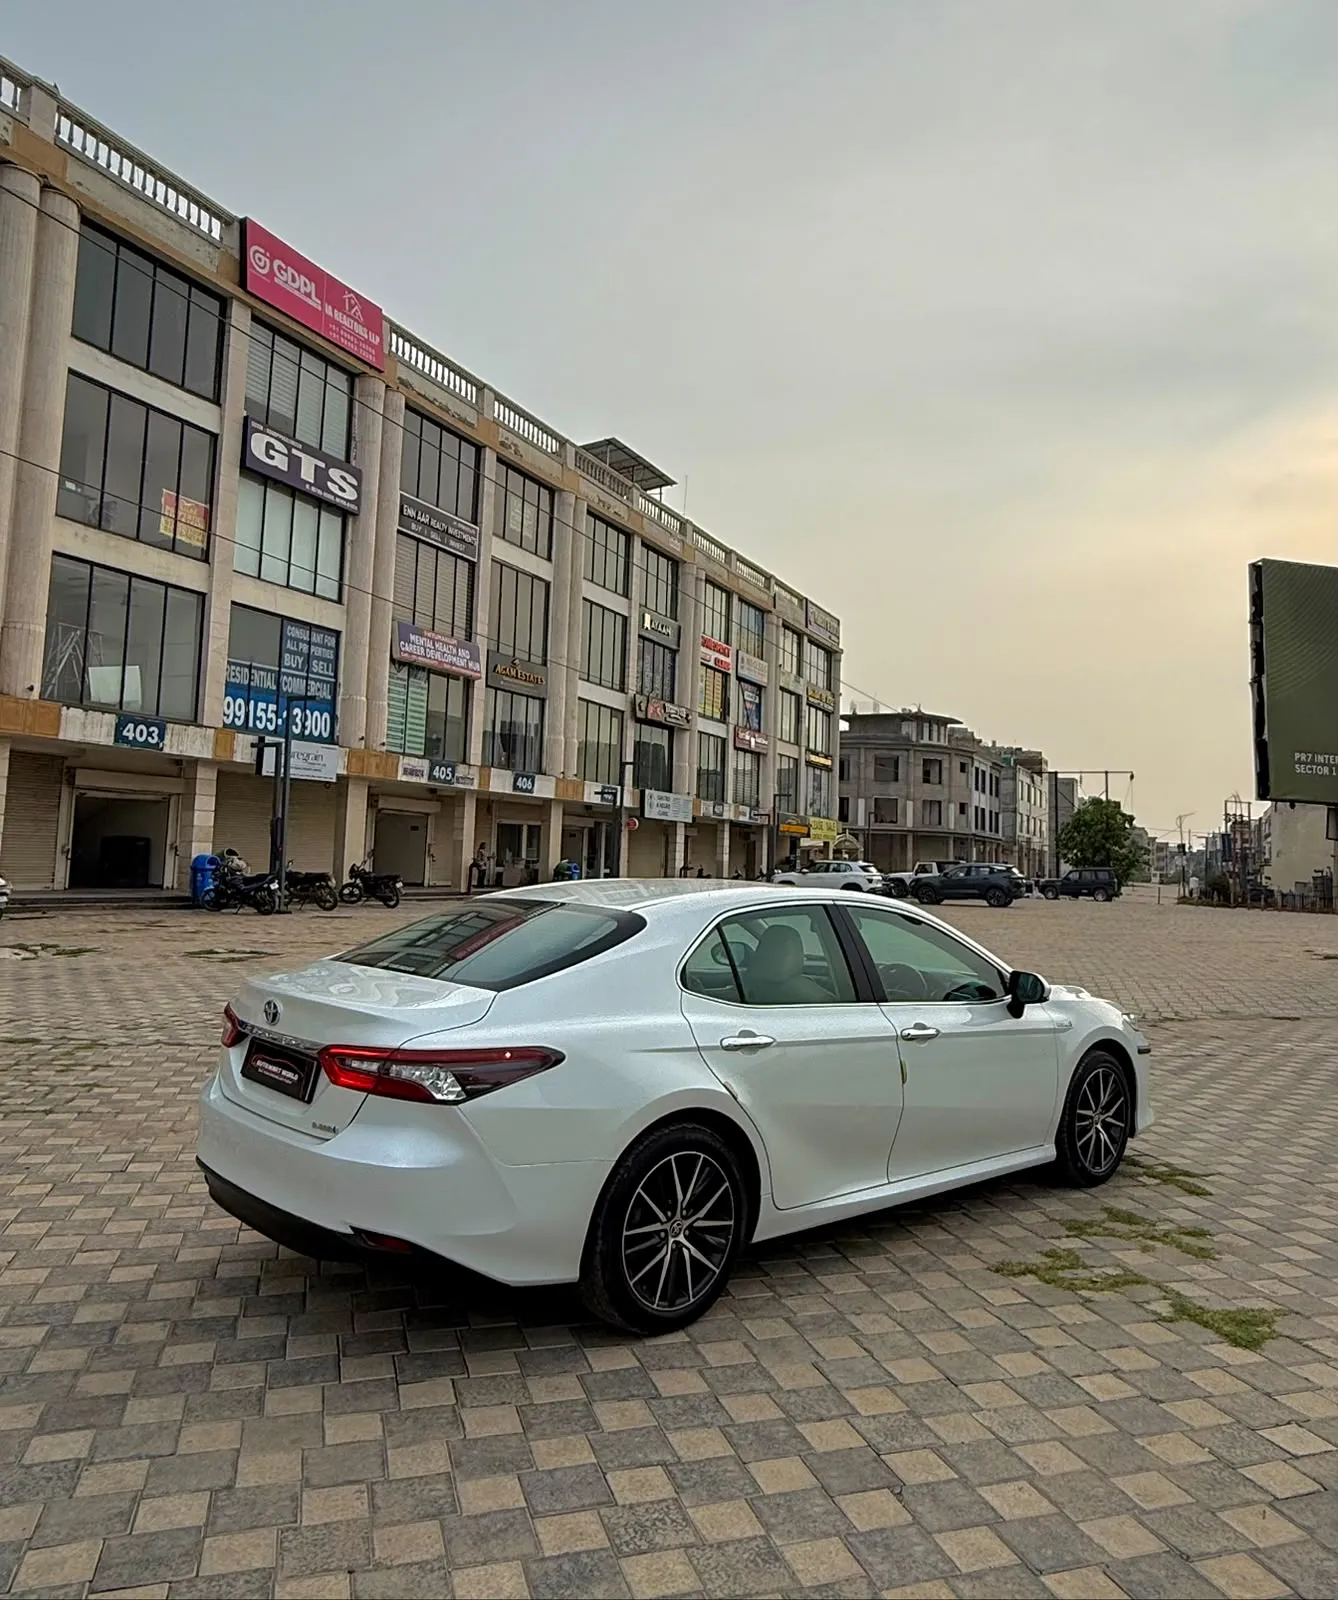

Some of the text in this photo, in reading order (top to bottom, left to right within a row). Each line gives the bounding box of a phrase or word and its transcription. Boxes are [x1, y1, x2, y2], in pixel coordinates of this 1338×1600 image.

[273, 259, 321, 304] GDPL
[334, 311, 368, 339] REALTORS
[251, 432, 358, 501] GTS
[286, 639, 297, 651] ALL
[400, 641, 425, 656] CAREER
[426, 648, 467, 668] DEVELOPMENT
[409, 633, 434, 650] MENTAL
[435, 641, 457, 655] HEALTH
[458, 648, 471, 660] AND
[284, 653, 334, 677] BUY SELL
[518, 670, 545, 685] ESTATES
[122, 722, 159, 744] 403
[1294, 752, 1312, 762] PR7
[433, 765, 452, 780] 405
[1295, 764, 1329, 775] SECTOR
[517, 777, 533, 790] 406
